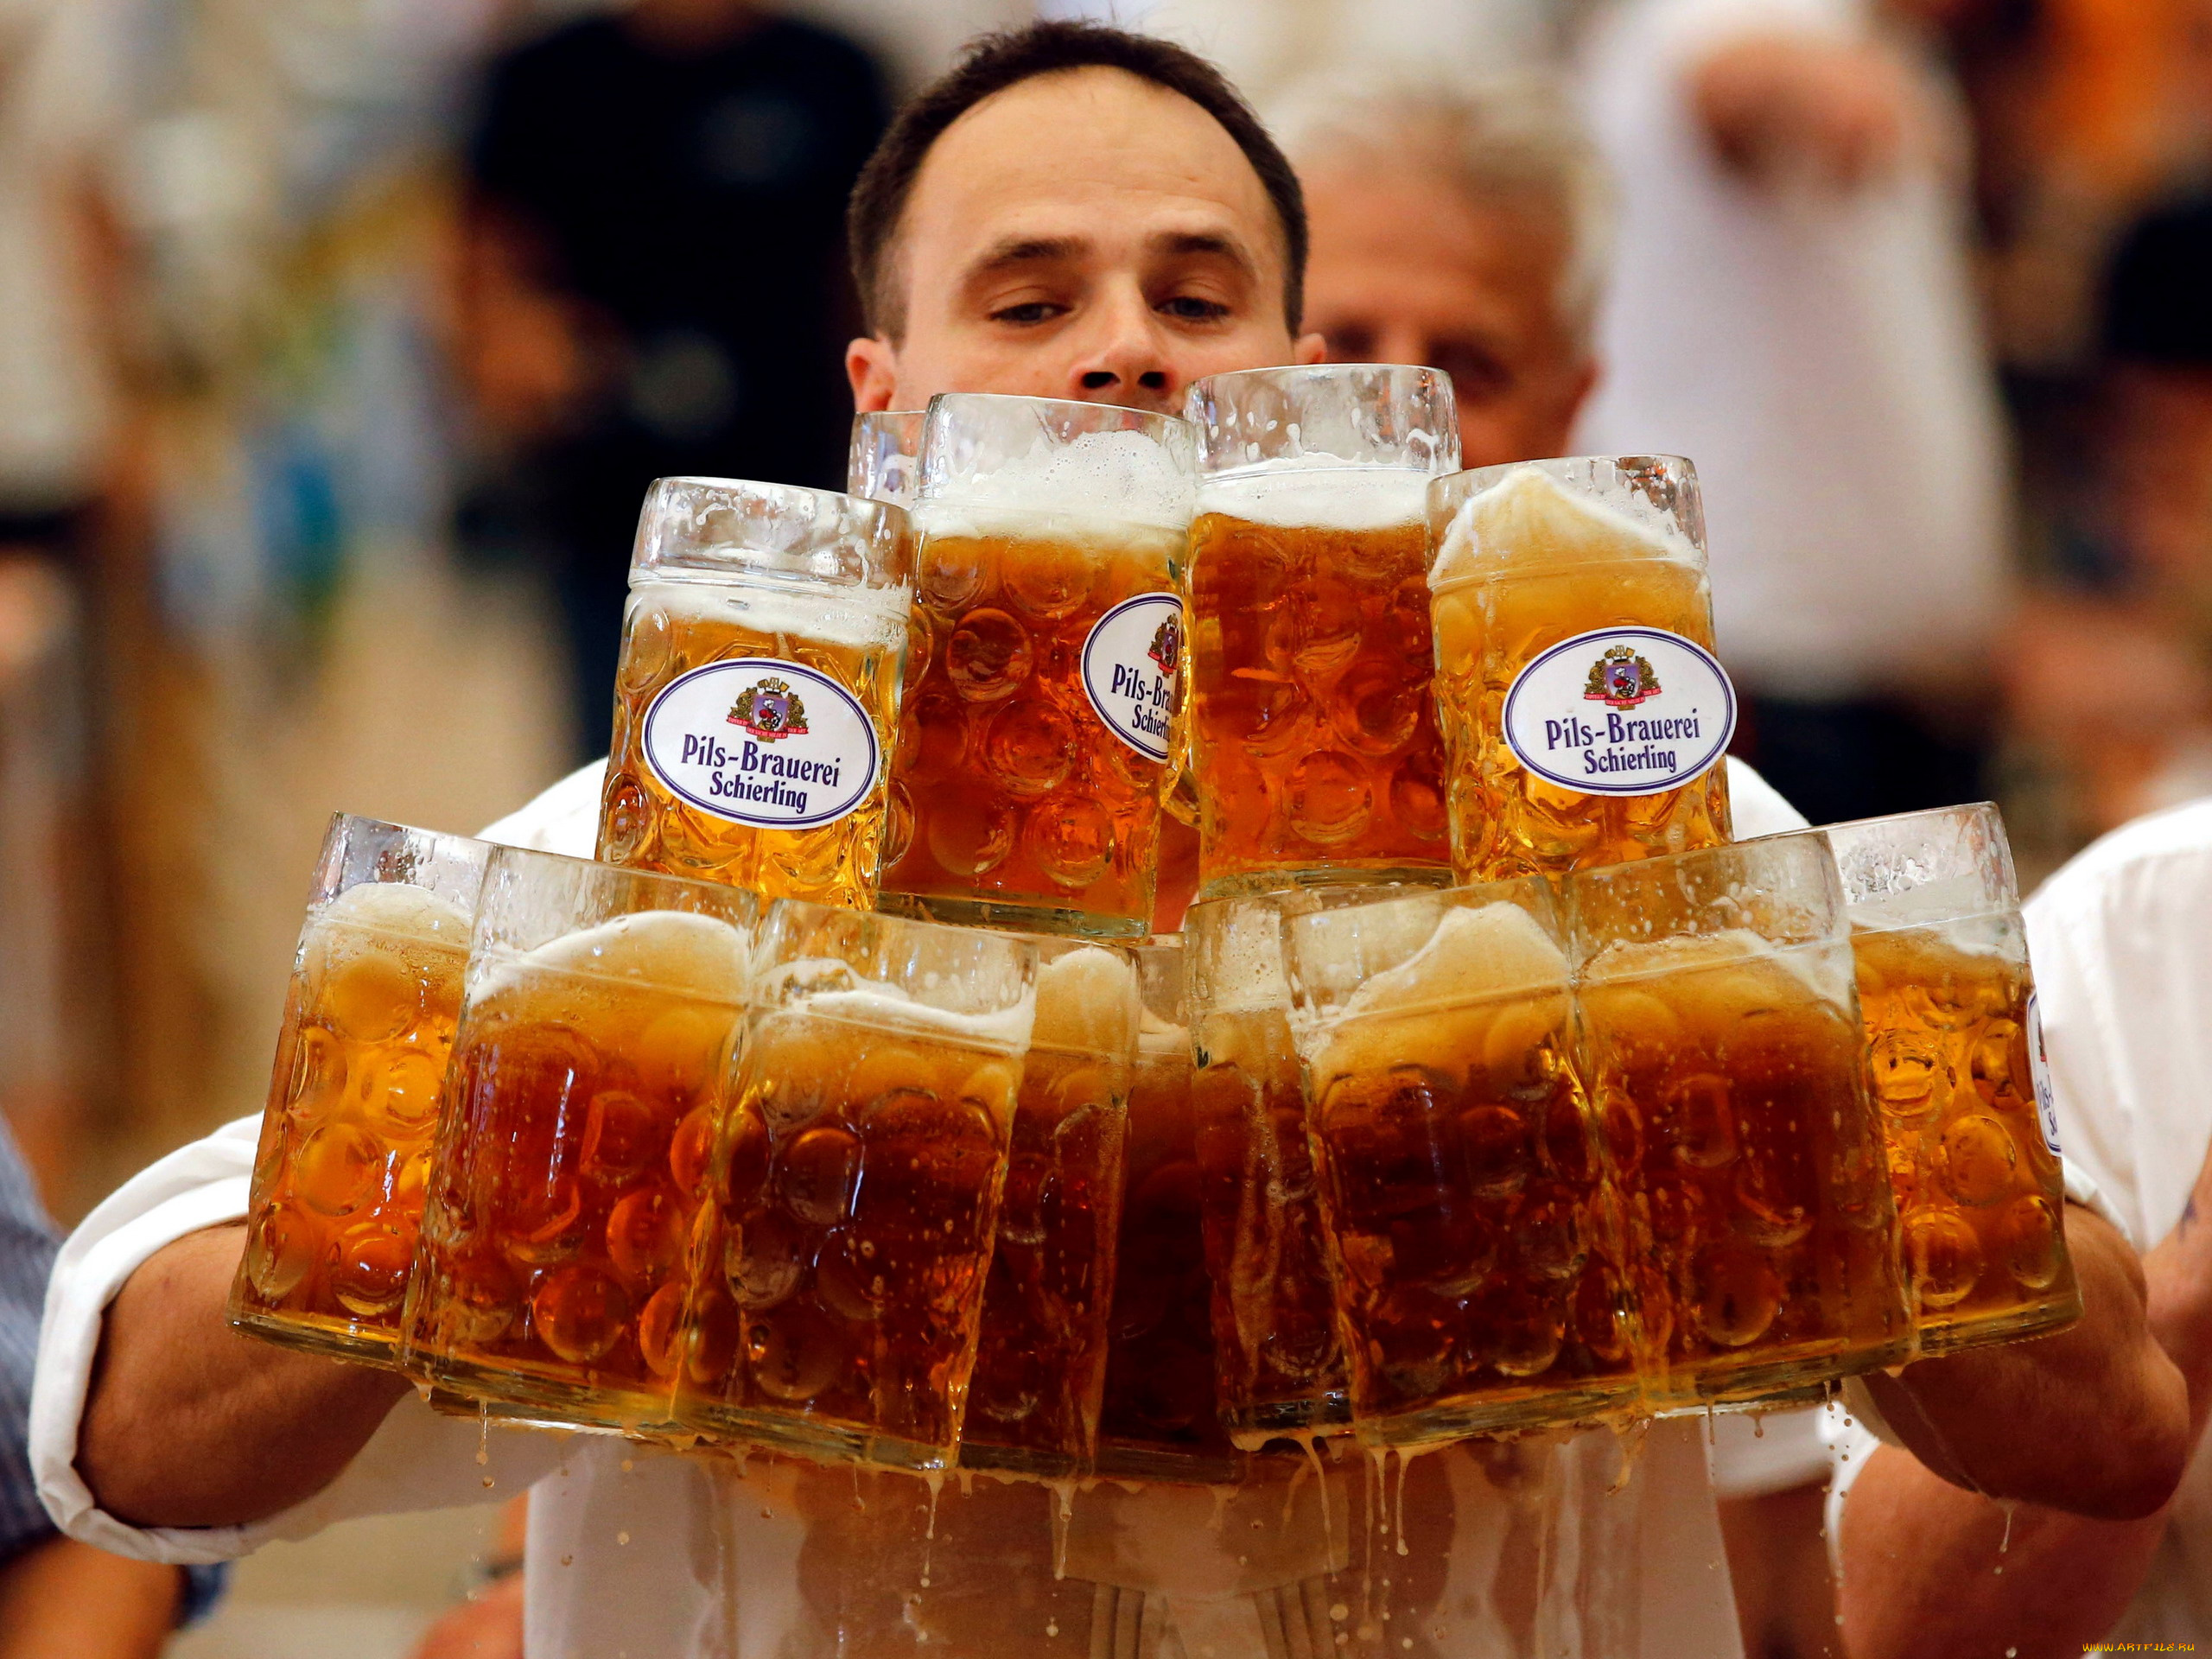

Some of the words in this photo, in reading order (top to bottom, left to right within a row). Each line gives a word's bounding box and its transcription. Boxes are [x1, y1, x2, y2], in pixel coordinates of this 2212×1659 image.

[1111, 664, 1173, 713] Pils-Bra
[1545, 708, 1700, 750] Pils-Brauerei
[681, 734, 842, 787] Pils-Brauerei
[1584, 744, 1678, 773] Schierling
[710, 772, 808, 814] Schierling
